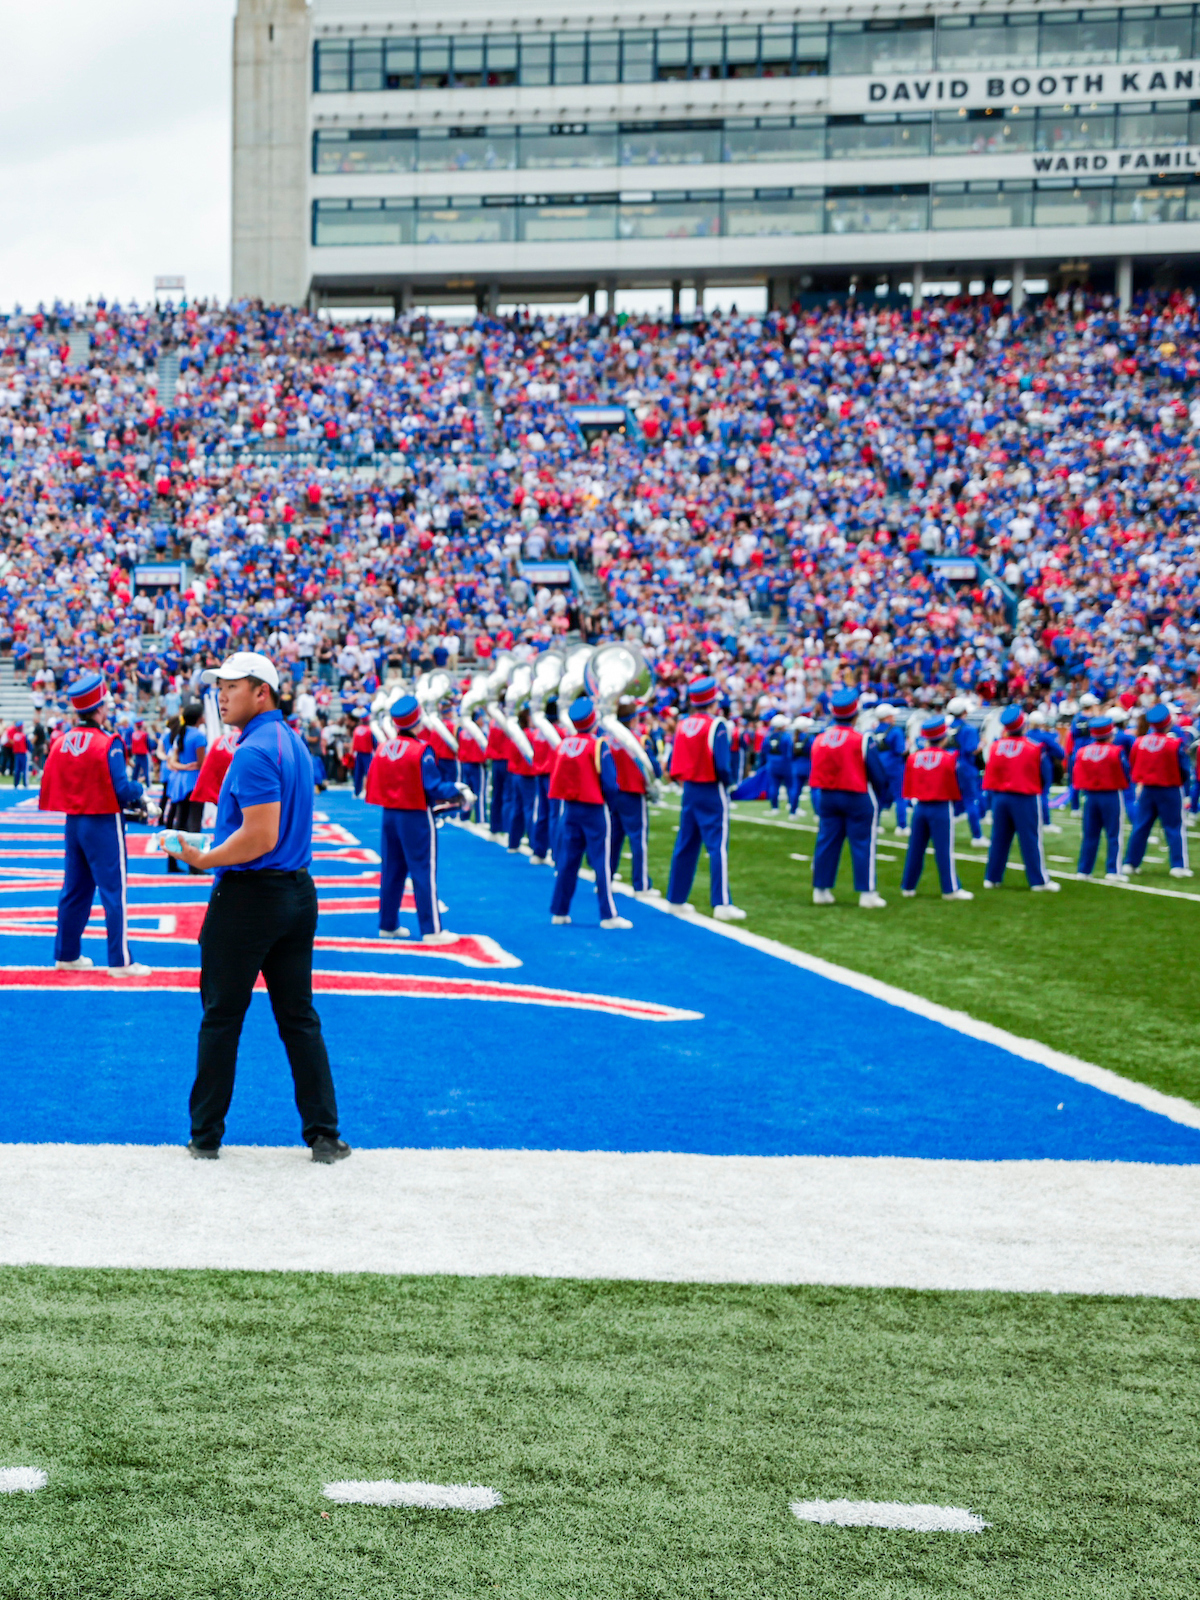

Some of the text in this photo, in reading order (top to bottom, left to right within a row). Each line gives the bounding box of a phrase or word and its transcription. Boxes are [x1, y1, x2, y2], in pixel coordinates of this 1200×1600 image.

[869, 69, 1200, 102] DAVID BOOTH KAN
[1033, 151, 1200, 172] WARD FAMIL
[60, 731, 94, 757] KU
[379, 739, 410, 762] KU
[558, 737, 589, 759] KU
